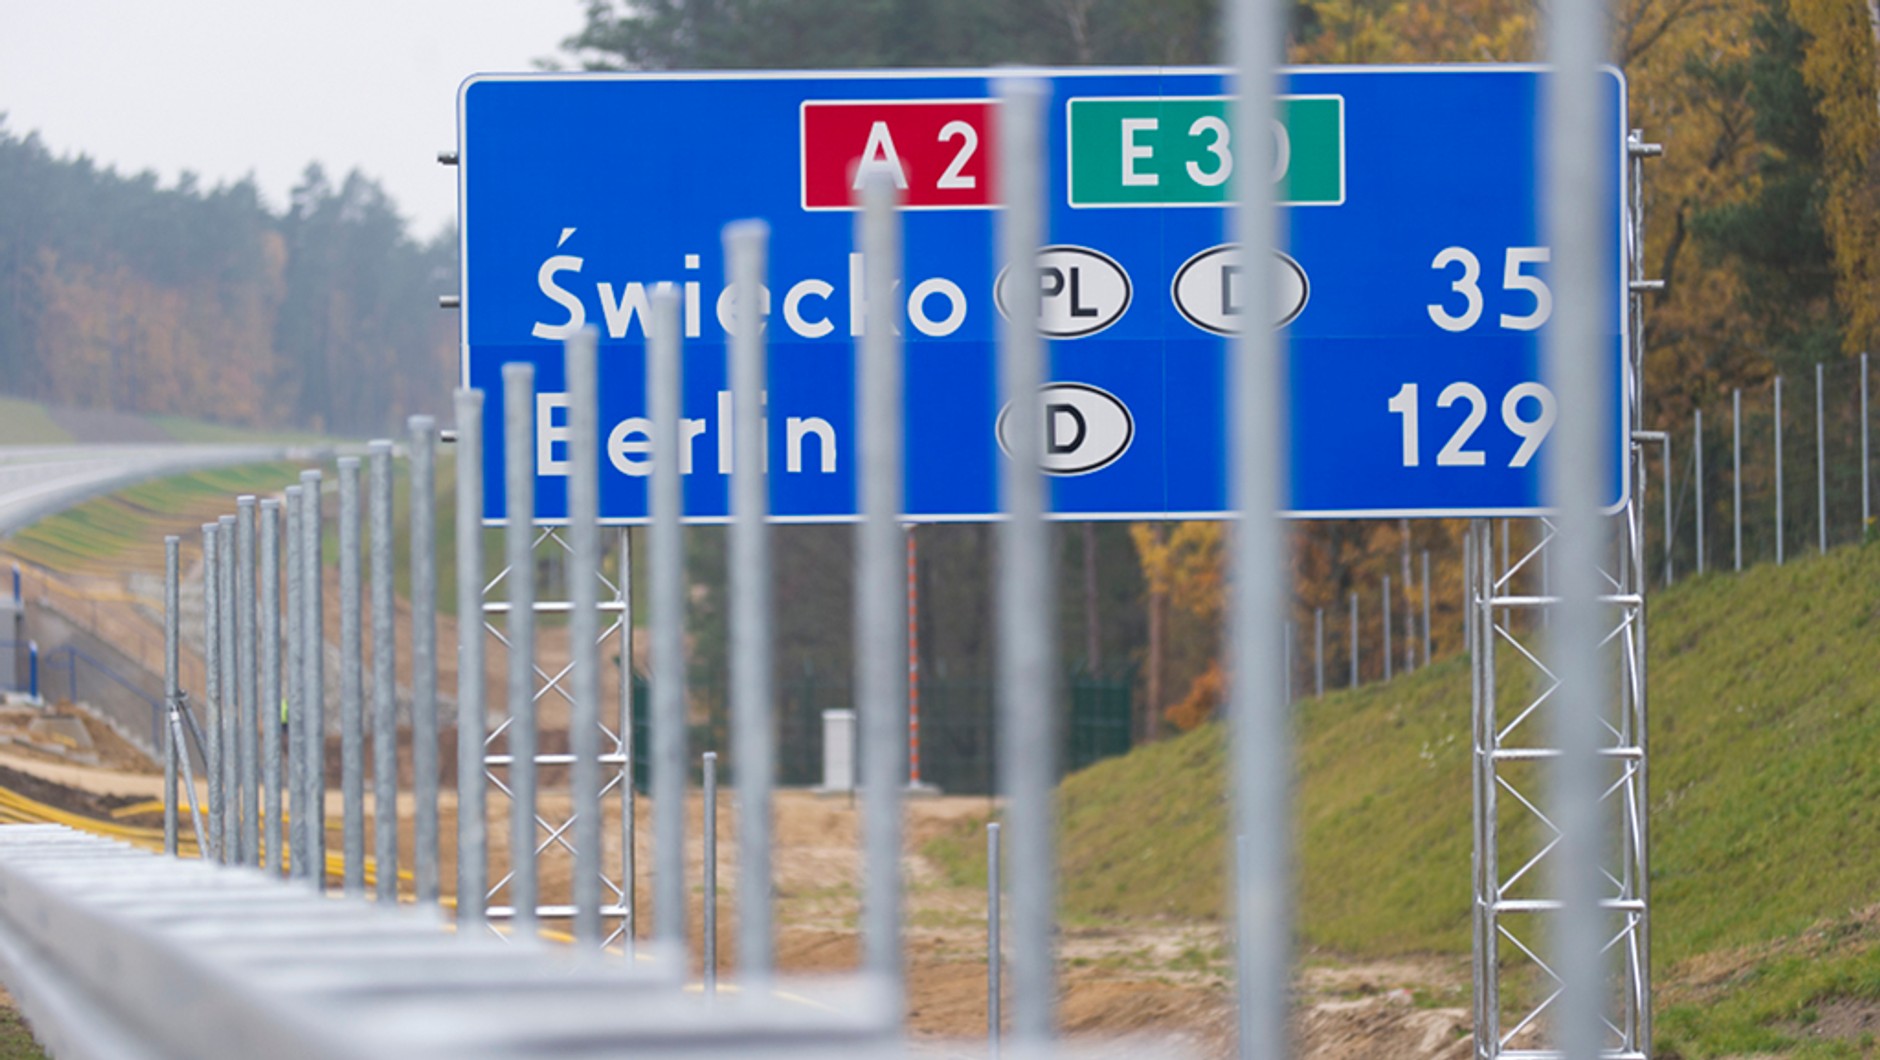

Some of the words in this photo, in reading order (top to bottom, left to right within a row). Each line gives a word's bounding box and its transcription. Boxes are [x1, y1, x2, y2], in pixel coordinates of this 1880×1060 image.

[852, 121, 909, 190] A
[936, 121, 978, 189] 2
[1121, 118, 1159, 186] E
[1037, 267, 1098, 317] PL
[1427, 246, 1553, 332] 35
[1046, 404, 1086, 454] D
[1388, 381, 1558, 467] 129
